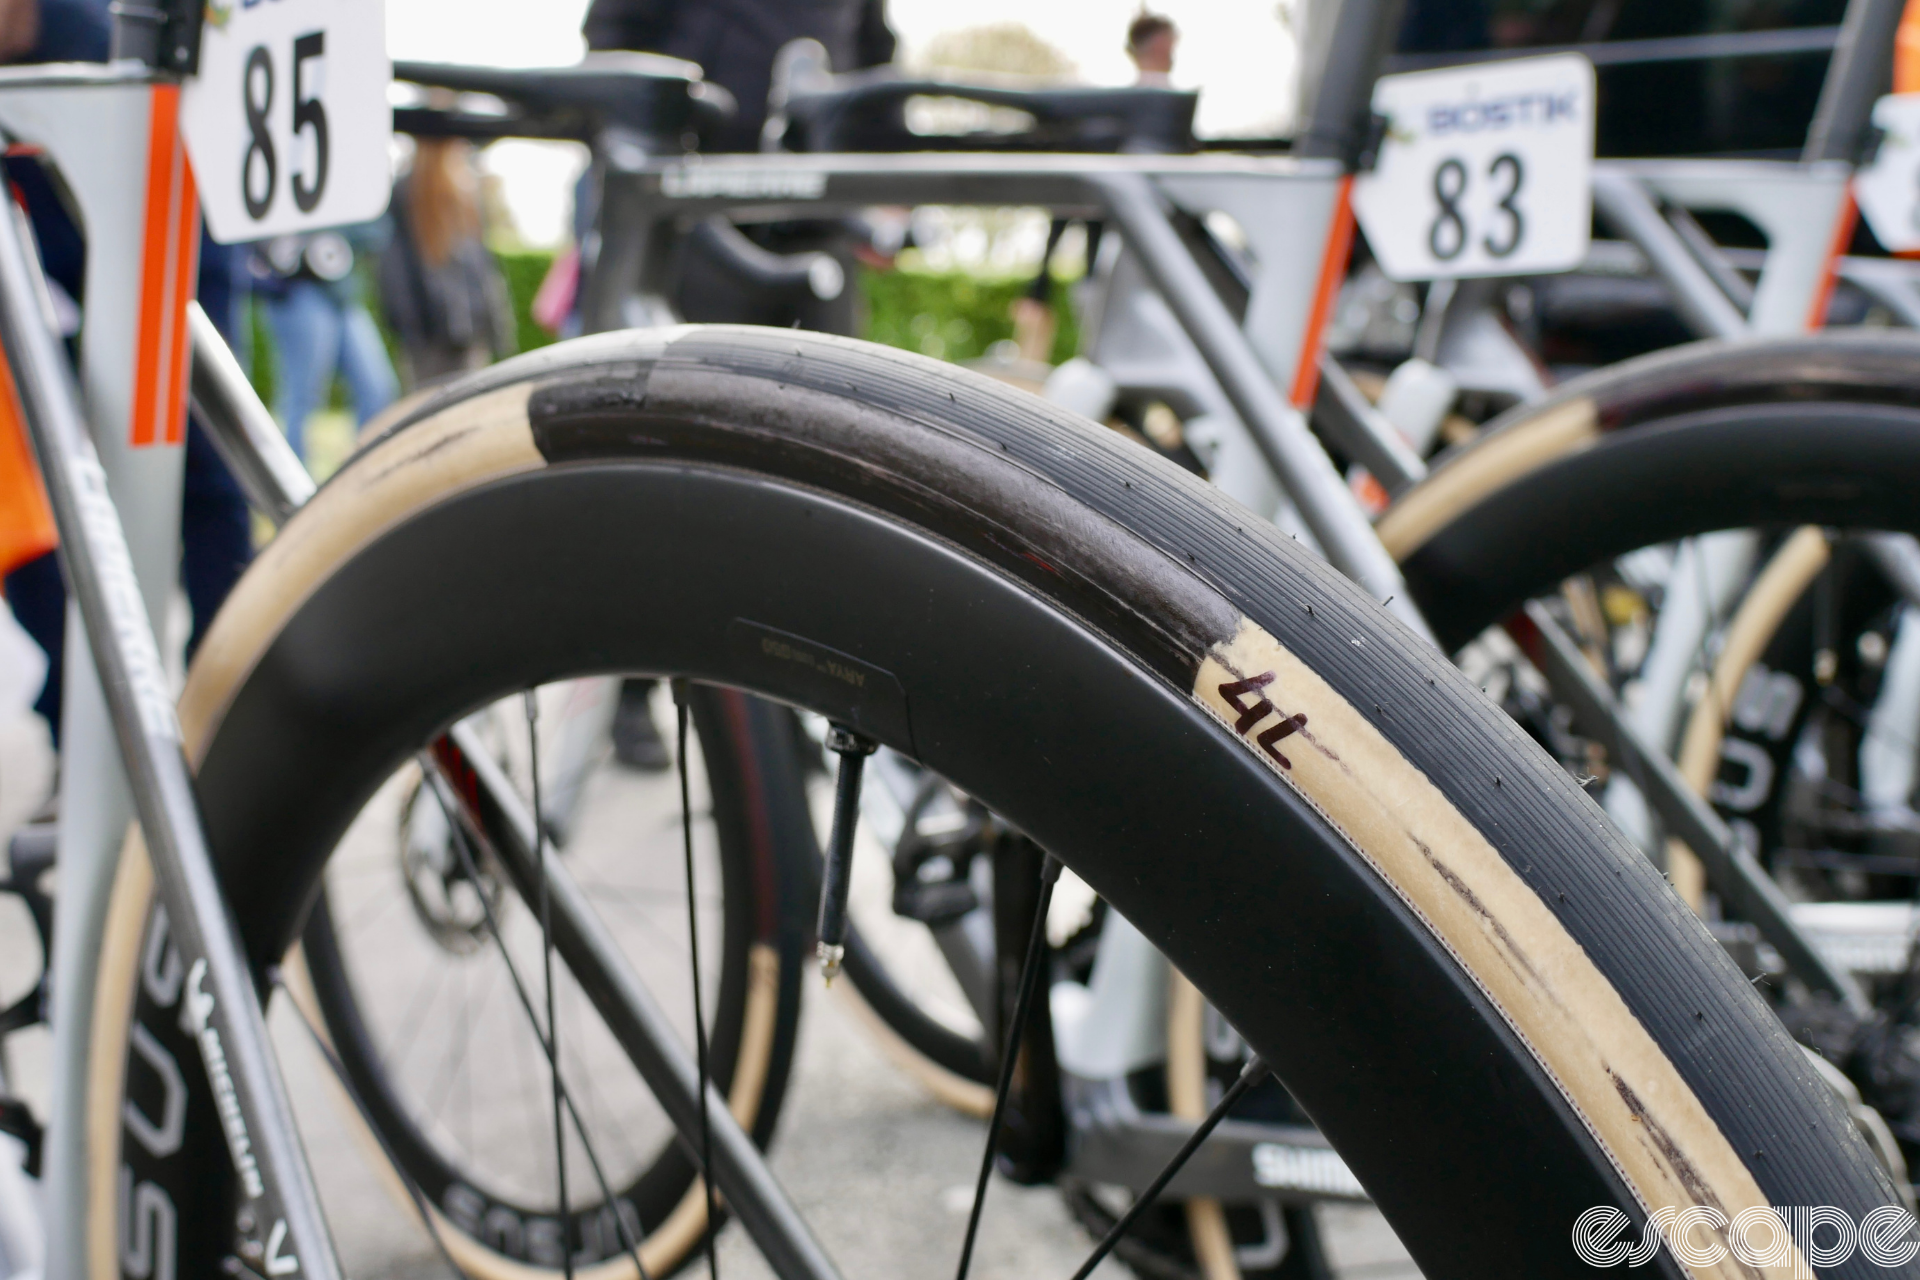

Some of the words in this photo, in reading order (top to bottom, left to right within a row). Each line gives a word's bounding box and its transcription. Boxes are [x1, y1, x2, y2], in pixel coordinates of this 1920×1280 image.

[243, 31, 329, 221] 85
[1429, 155, 1524, 260] 83
[1218, 670, 1308, 770] 4L
[203, 1027, 264, 1199] MICHELIN
